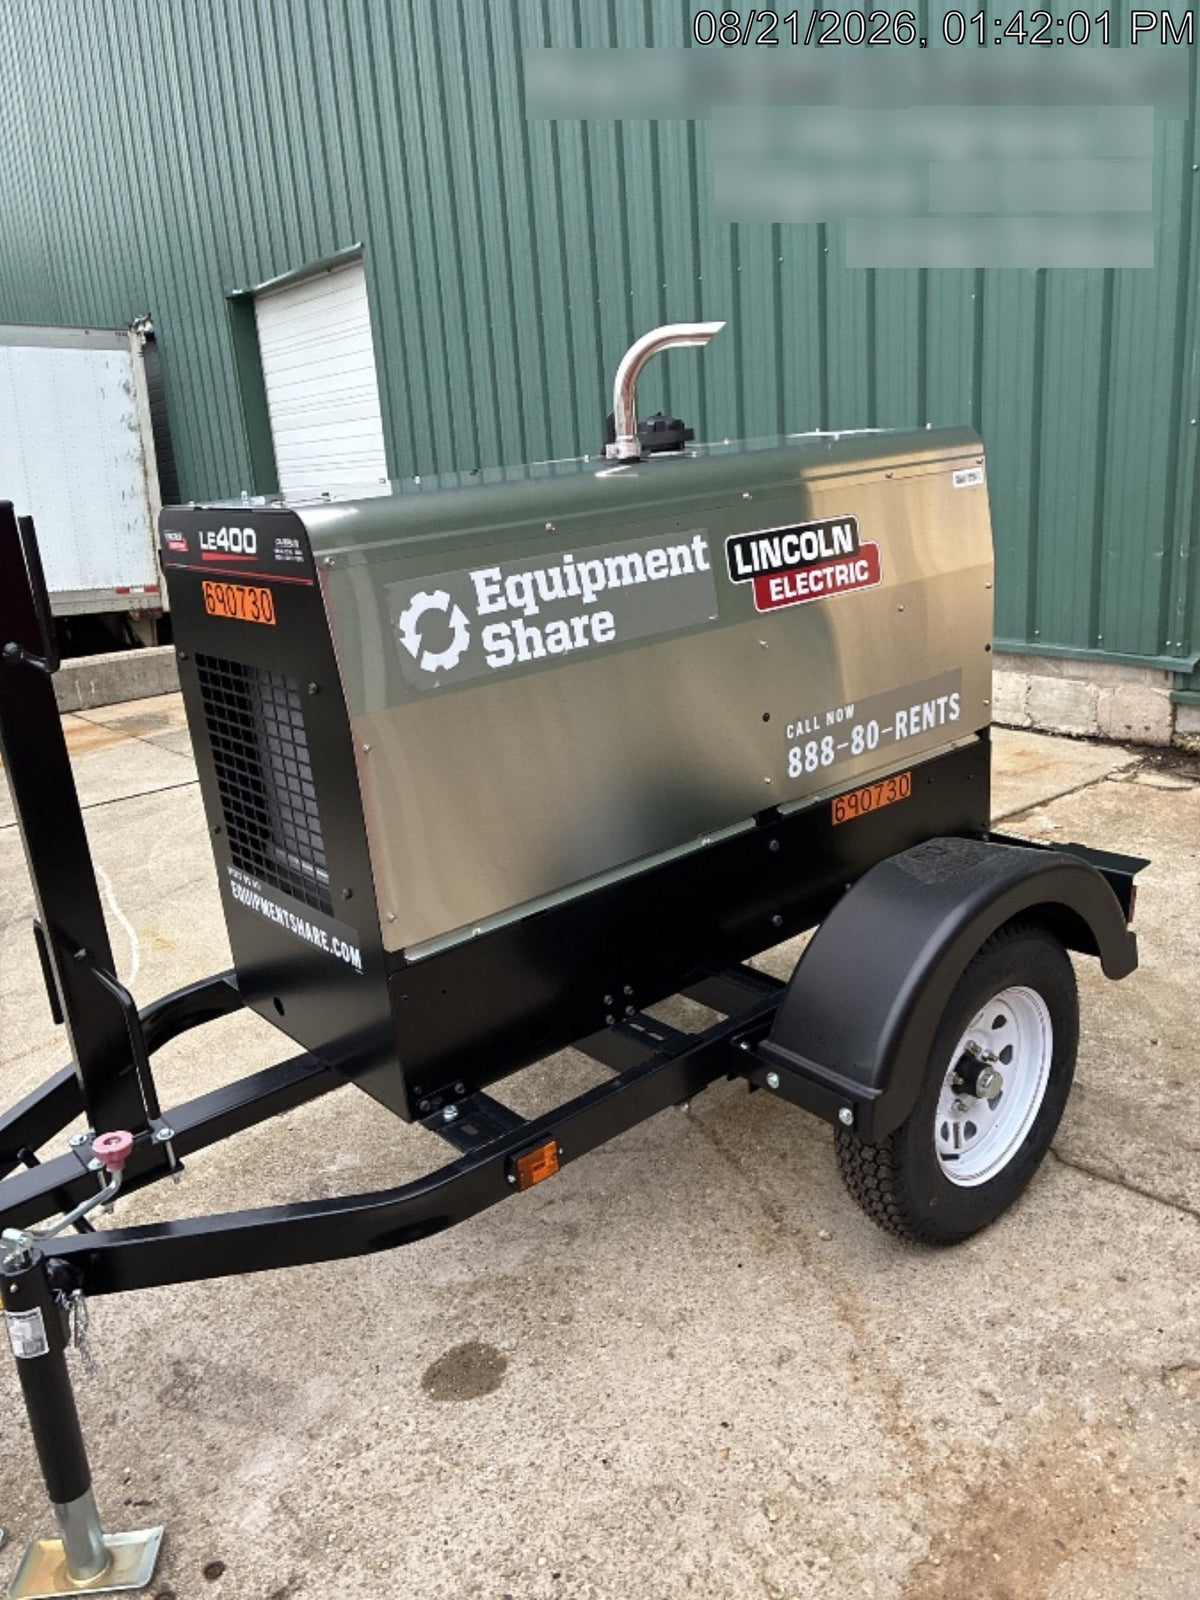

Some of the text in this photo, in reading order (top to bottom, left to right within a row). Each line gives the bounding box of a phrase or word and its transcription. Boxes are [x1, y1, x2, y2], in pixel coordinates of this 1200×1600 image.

[199, 527, 257, 554] LE400
[734, 524, 854, 575] LINCOLN
[469, 534, 711, 616] Equipment
[769, 560, 869, 602] ELECTRIC
[205, 583, 273, 623] 690730
[481, 610, 616, 669] Share
[787, 703, 855, 739] CALL NOW
[788, 692, 961, 778] 888-80-RENTS
[835, 774, 910, 823] 690730
[230, 879, 363, 970] EQUIPMENTSHARE.COM
